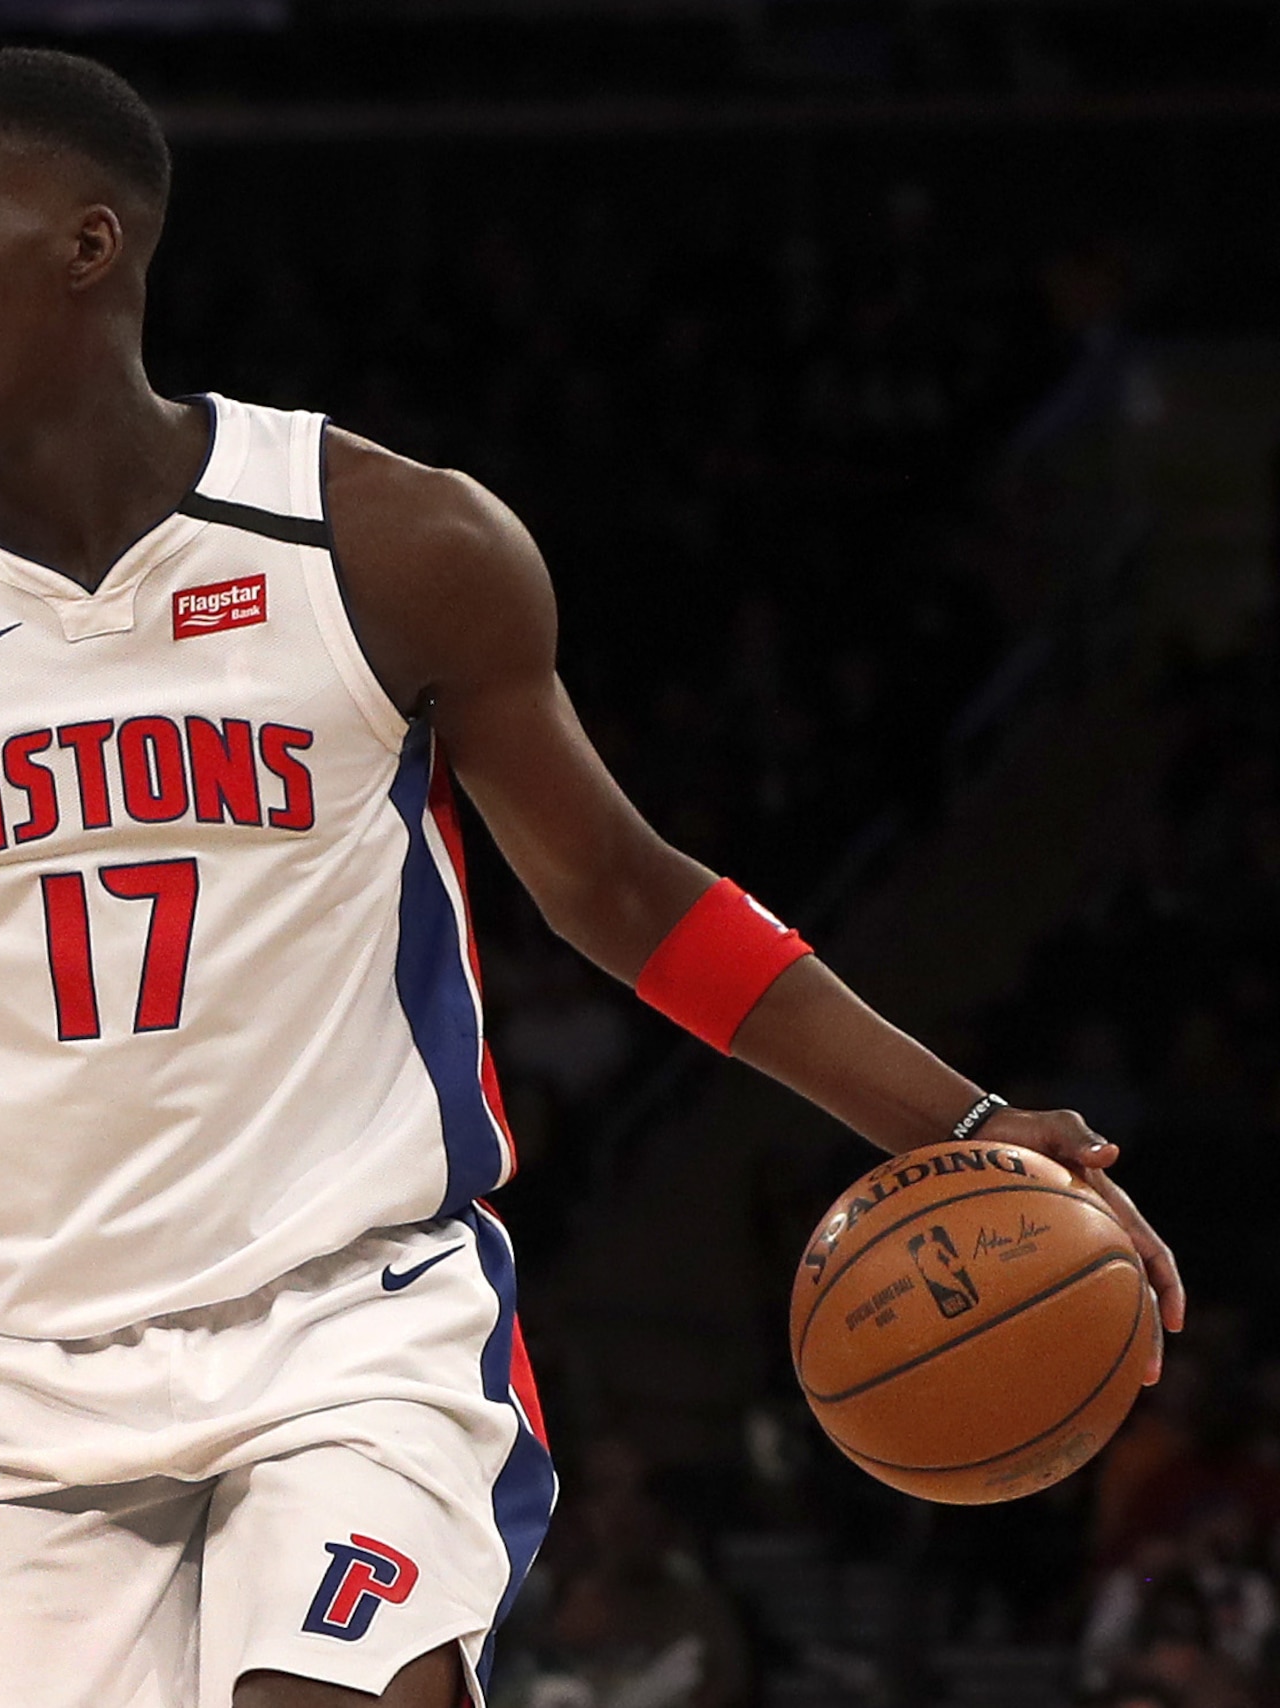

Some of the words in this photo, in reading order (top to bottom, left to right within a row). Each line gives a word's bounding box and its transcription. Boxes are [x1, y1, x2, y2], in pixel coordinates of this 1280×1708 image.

[178, 585, 261, 615] Flagstar
[231, 605, 260, 620] Bank
[40, 857, 200, 1042] 17
[953, 1099, 990, 1138] Never
[805, 1148, 1032, 1285] SPALDING
